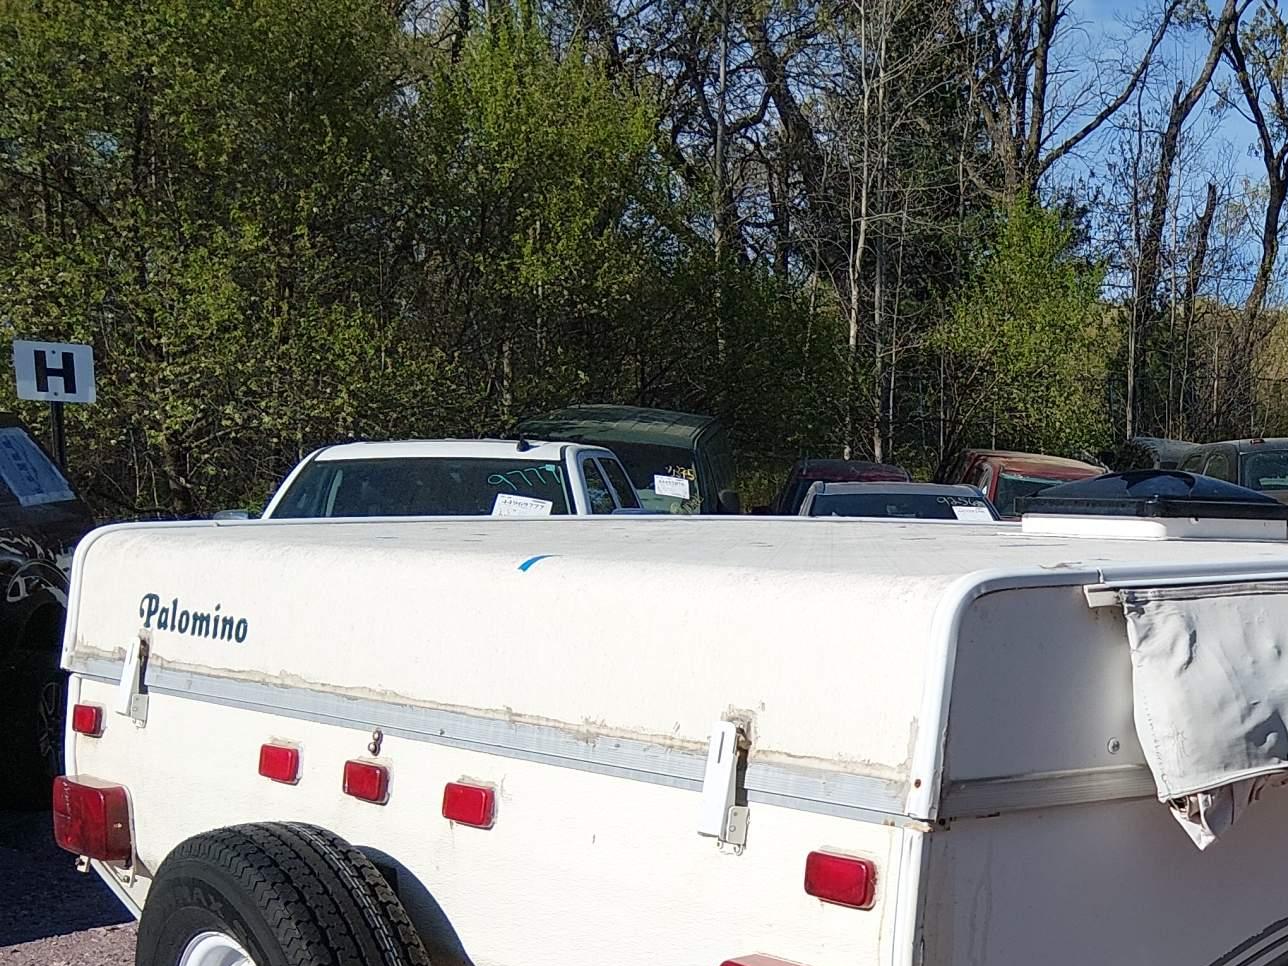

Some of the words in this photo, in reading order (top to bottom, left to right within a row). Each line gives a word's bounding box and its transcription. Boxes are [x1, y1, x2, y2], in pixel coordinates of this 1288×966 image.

[33, 350, 77, 394] H
[487, 466, 561, 491] 9777
[139, 592, 249, 643] Palomino
